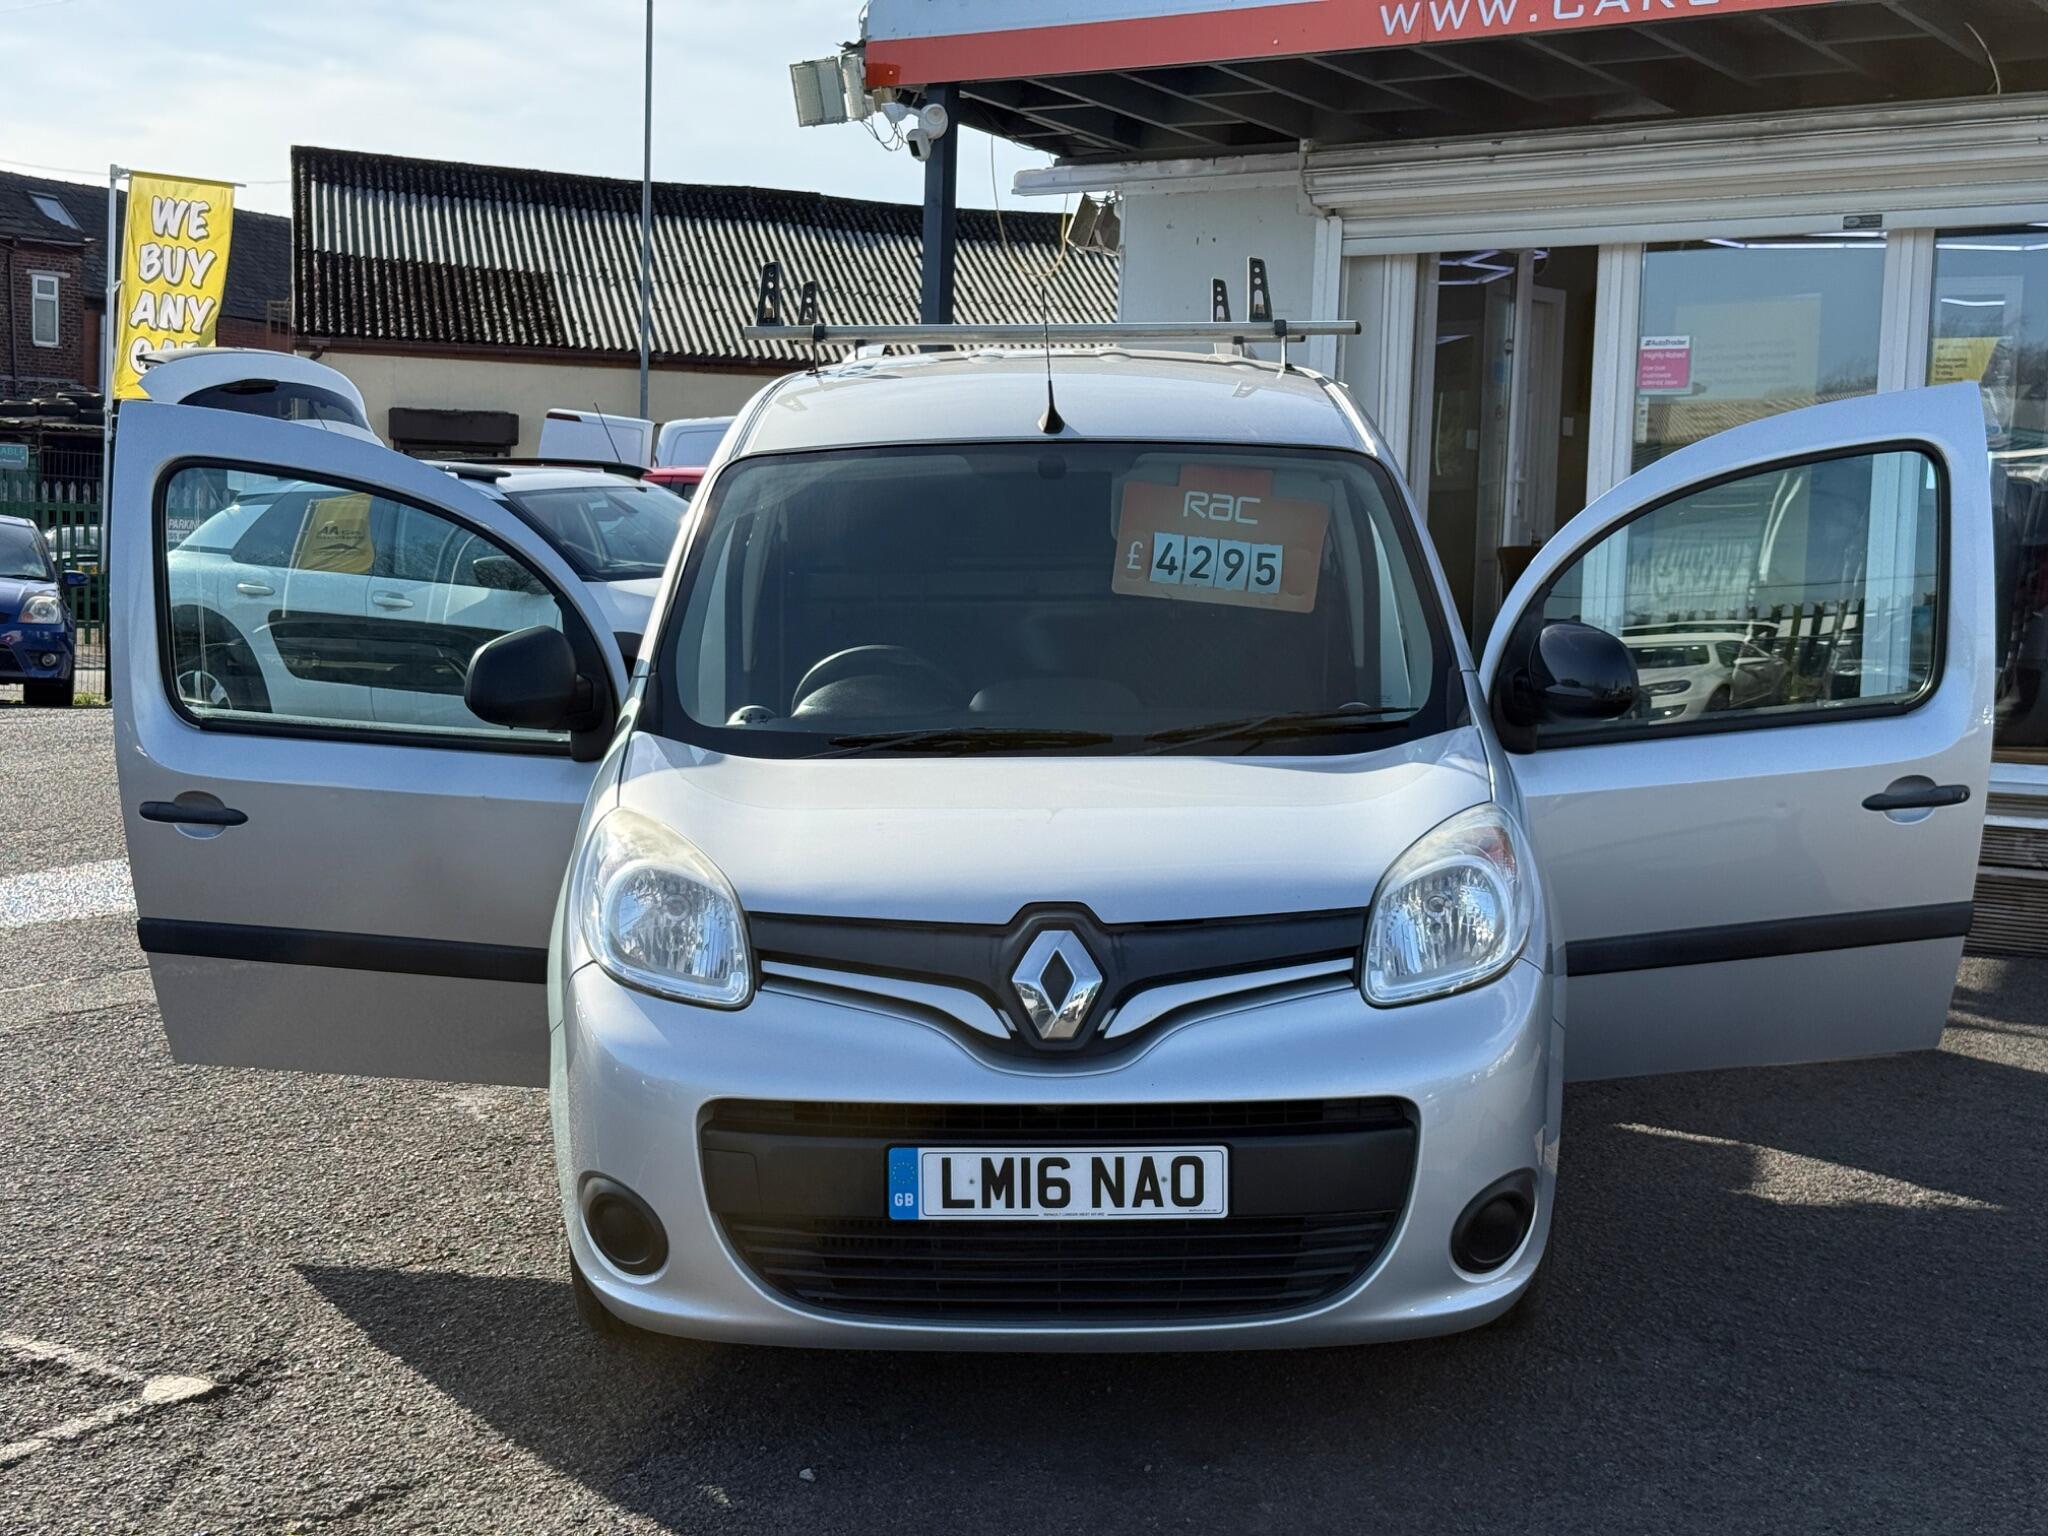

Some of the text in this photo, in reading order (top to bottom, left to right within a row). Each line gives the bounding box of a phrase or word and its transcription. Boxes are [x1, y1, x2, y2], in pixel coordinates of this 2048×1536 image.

[152, 195, 211, 241] WE
[139, 242, 217, 288] BUY
[129, 289, 215, 333] ANY
[168, 518, 202, 529] PARKIN
[894, 1193, 914, 1206] GB
[941, 1155, 1205, 1208] LM16 NAO
